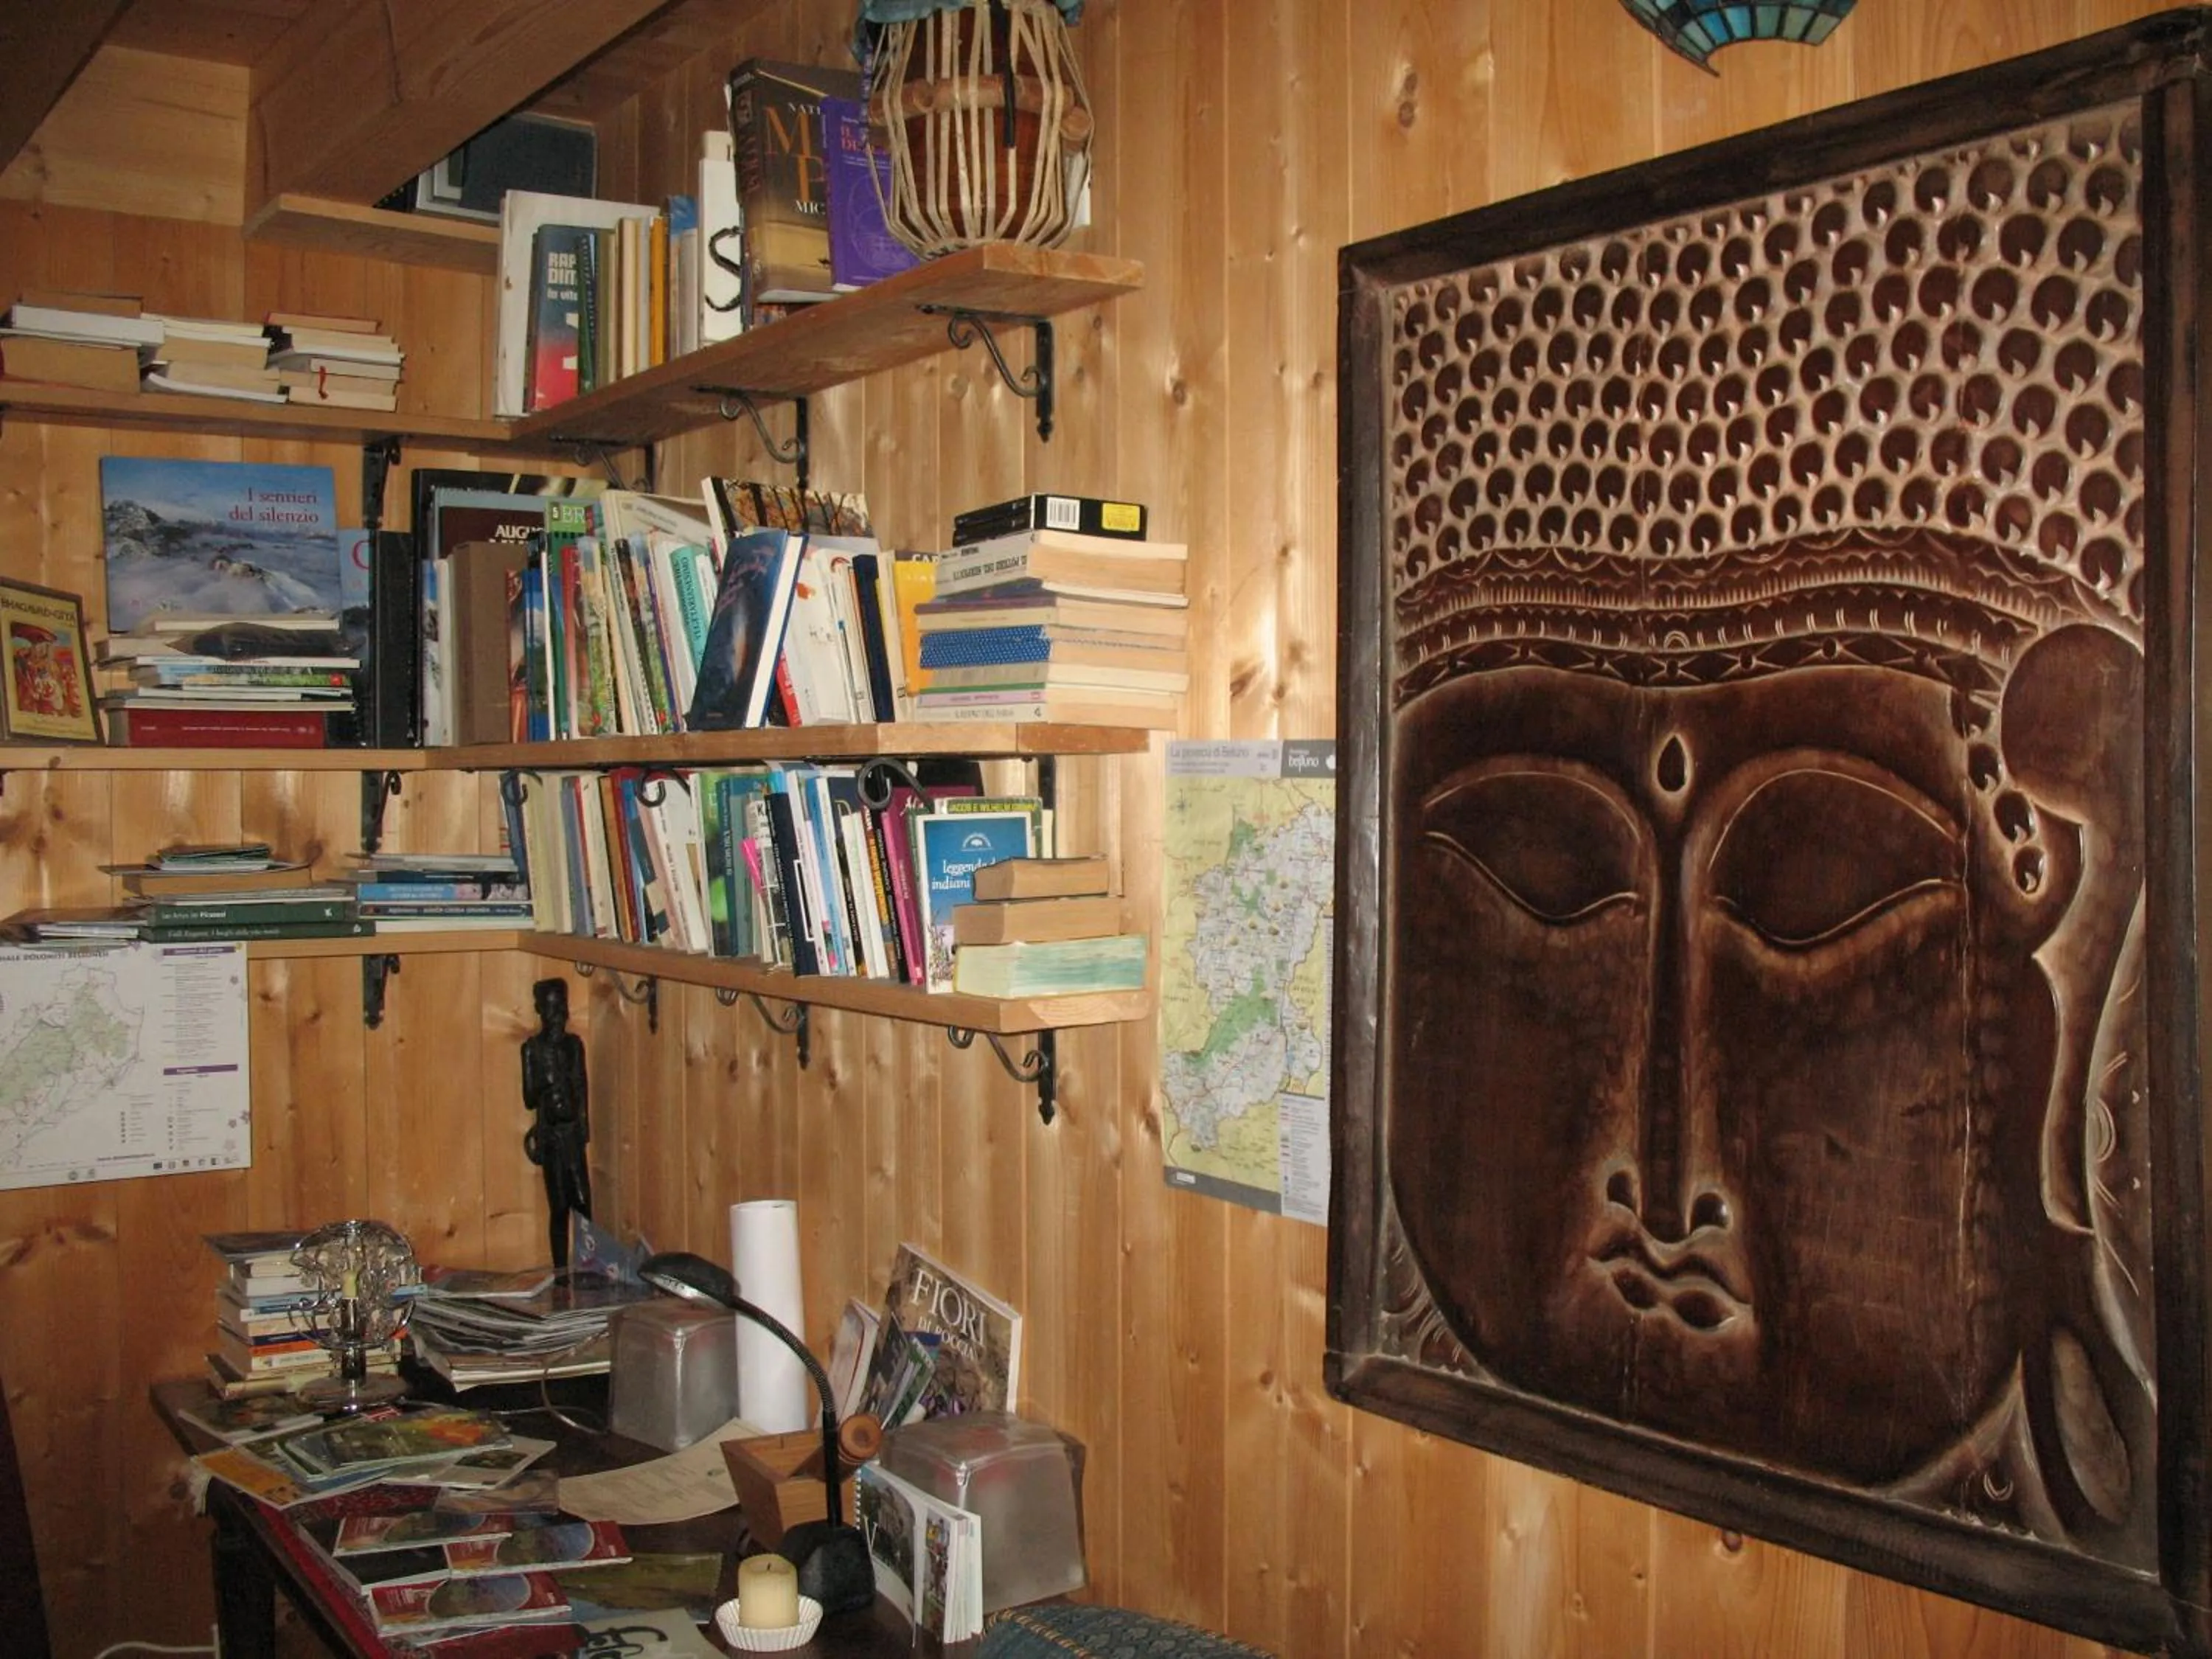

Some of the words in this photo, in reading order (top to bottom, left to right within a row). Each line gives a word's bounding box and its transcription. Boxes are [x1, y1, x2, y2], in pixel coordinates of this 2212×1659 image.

[248, 487, 254, 502] I
[259, 490, 318, 504] sentieri
[229, 504, 253, 521] del
[259, 507, 319, 523] silenzio
[910, 1268, 987, 1347] FIORI
